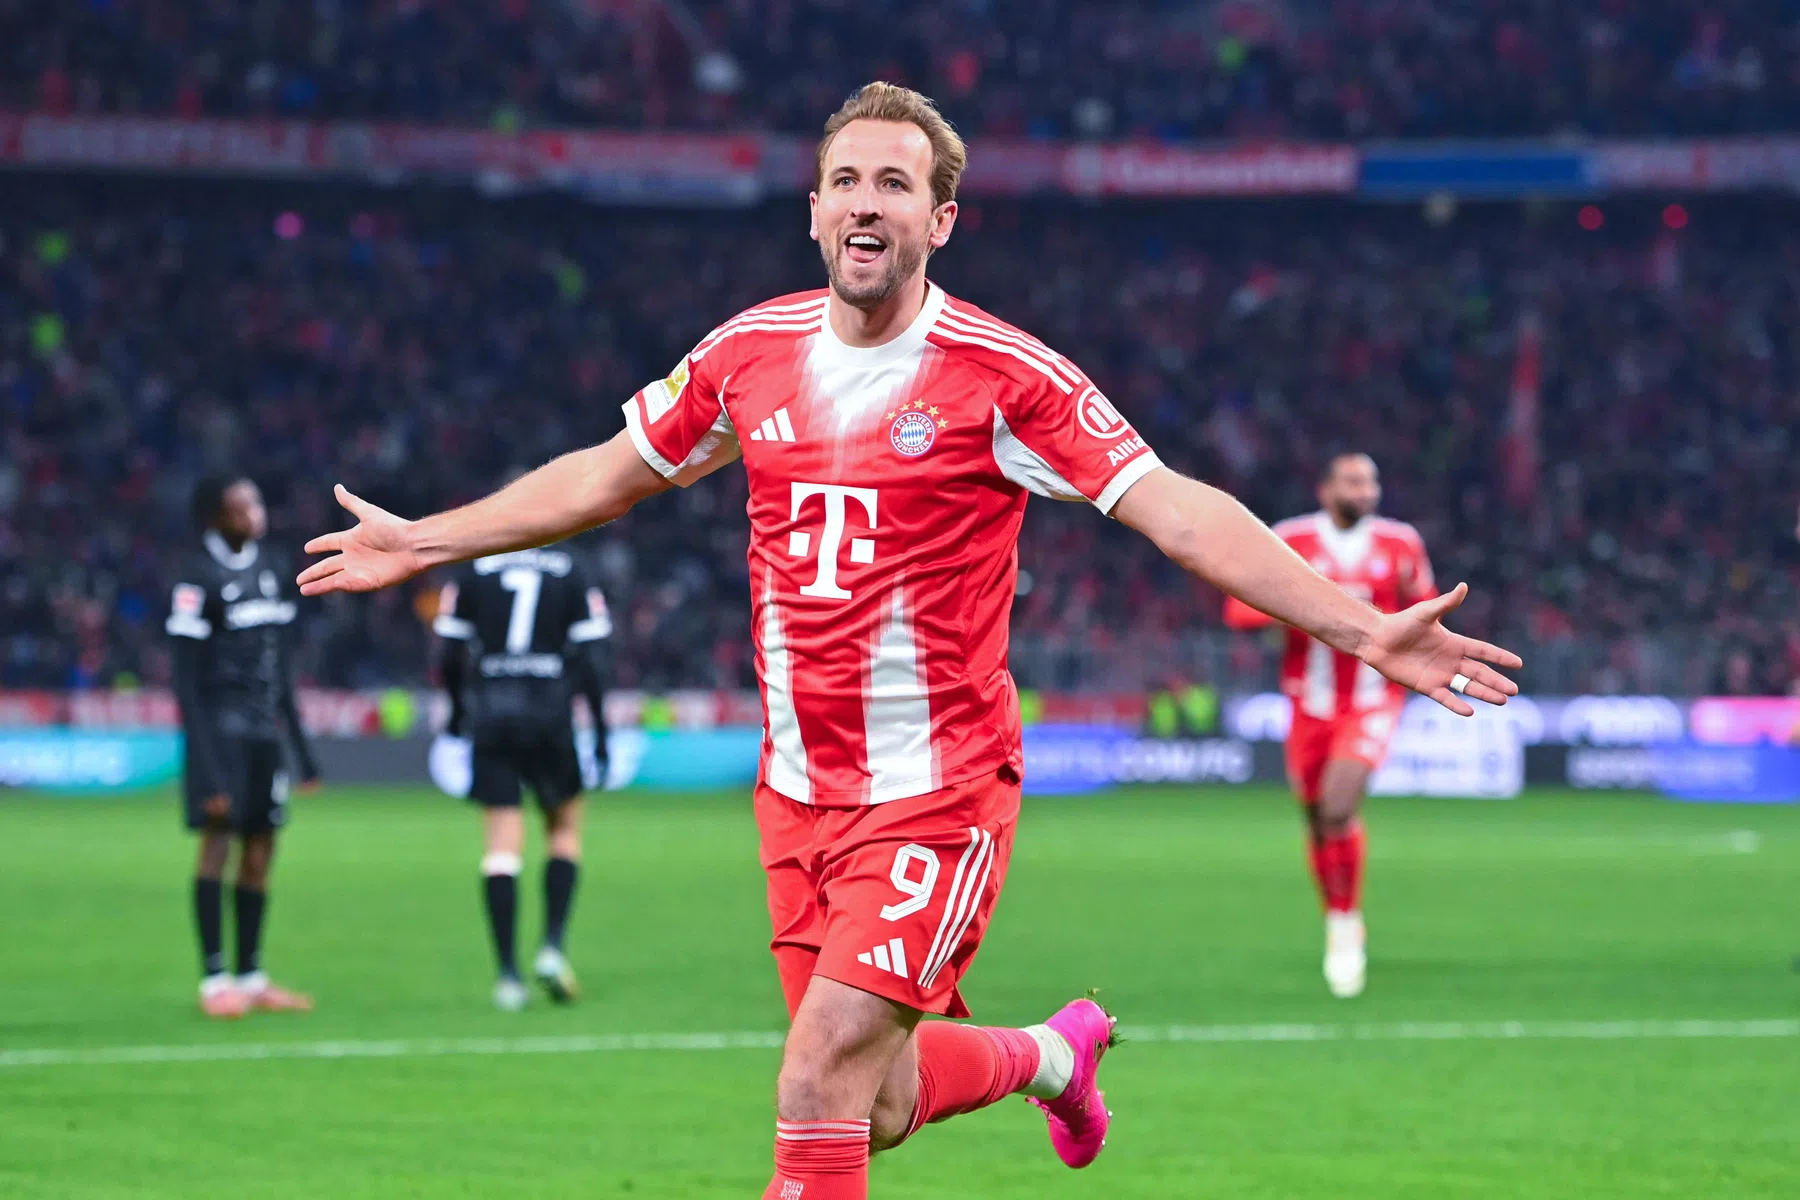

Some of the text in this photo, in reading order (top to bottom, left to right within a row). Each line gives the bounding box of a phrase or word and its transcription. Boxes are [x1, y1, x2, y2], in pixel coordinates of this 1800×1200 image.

[896, 415, 932, 434] FC BAYERN
[1106, 436, 1148, 467] Allia
[788, 481, 878, 600] T
[879, 843, 940, 921] 9
